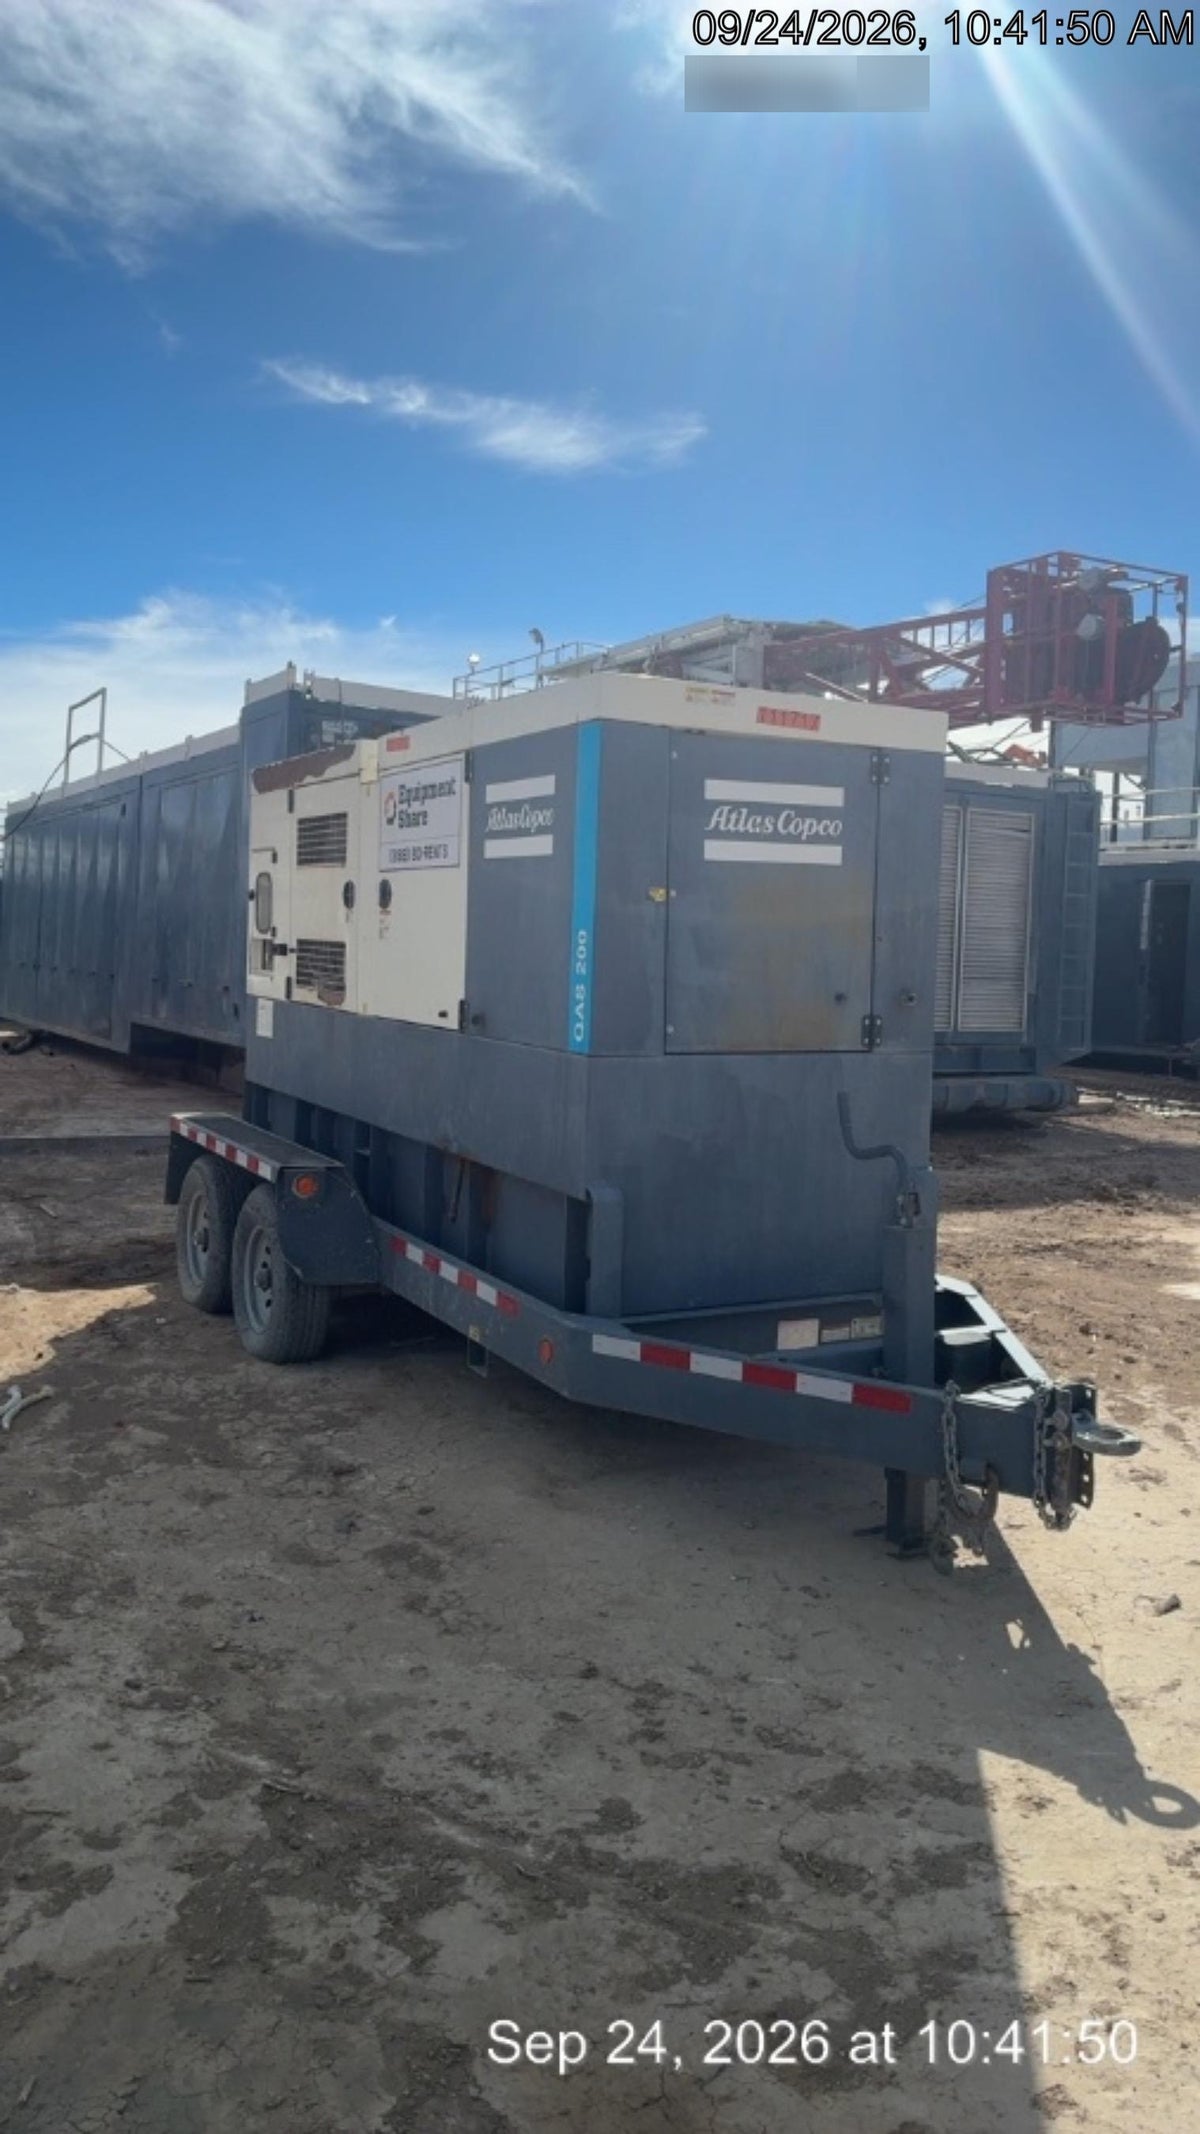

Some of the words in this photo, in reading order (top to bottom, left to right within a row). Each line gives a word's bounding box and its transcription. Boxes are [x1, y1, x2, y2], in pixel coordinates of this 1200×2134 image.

[398, 776, 456, 808] Equipment
[398, 809, 428, 828] Share
[704, 805, 774, 833] Atlas
[777, 809, 843, 840] Copco
[575, 929, 588, 976] 200
[574, 983, 586, 1042] QAS
